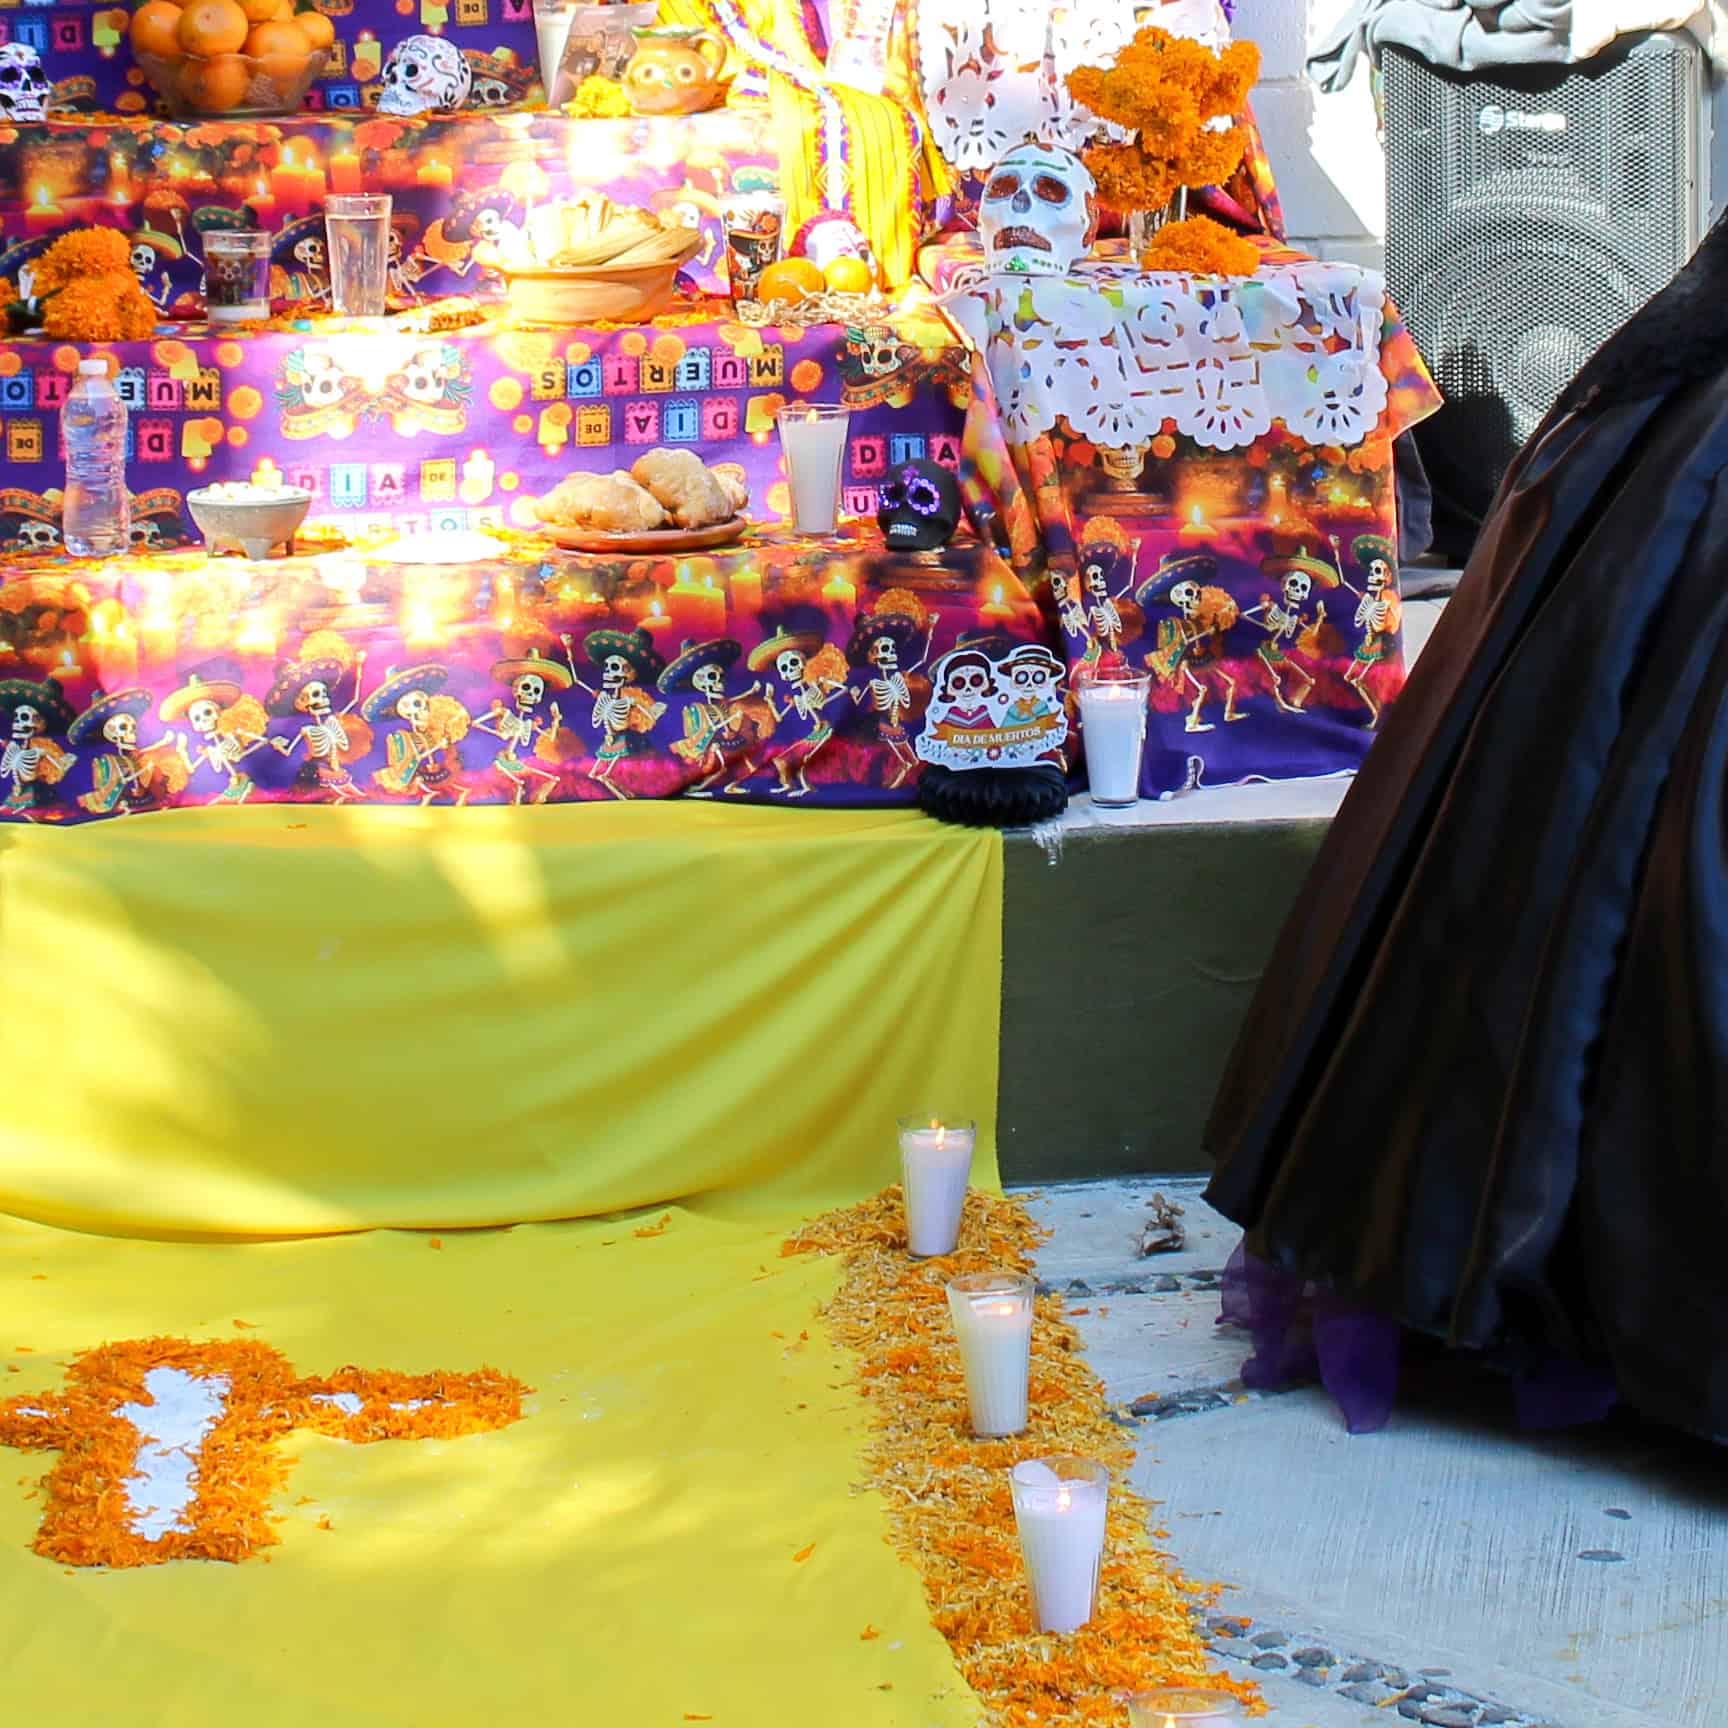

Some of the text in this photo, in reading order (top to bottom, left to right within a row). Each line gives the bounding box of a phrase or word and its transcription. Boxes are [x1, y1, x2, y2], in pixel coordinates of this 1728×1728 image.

[542, 359, 777, 389] MUERTOS
[634, 412, 729, 434] DIA
[860, 443, 957, 464] DIA
[298, 473, 400, 492] DIA
